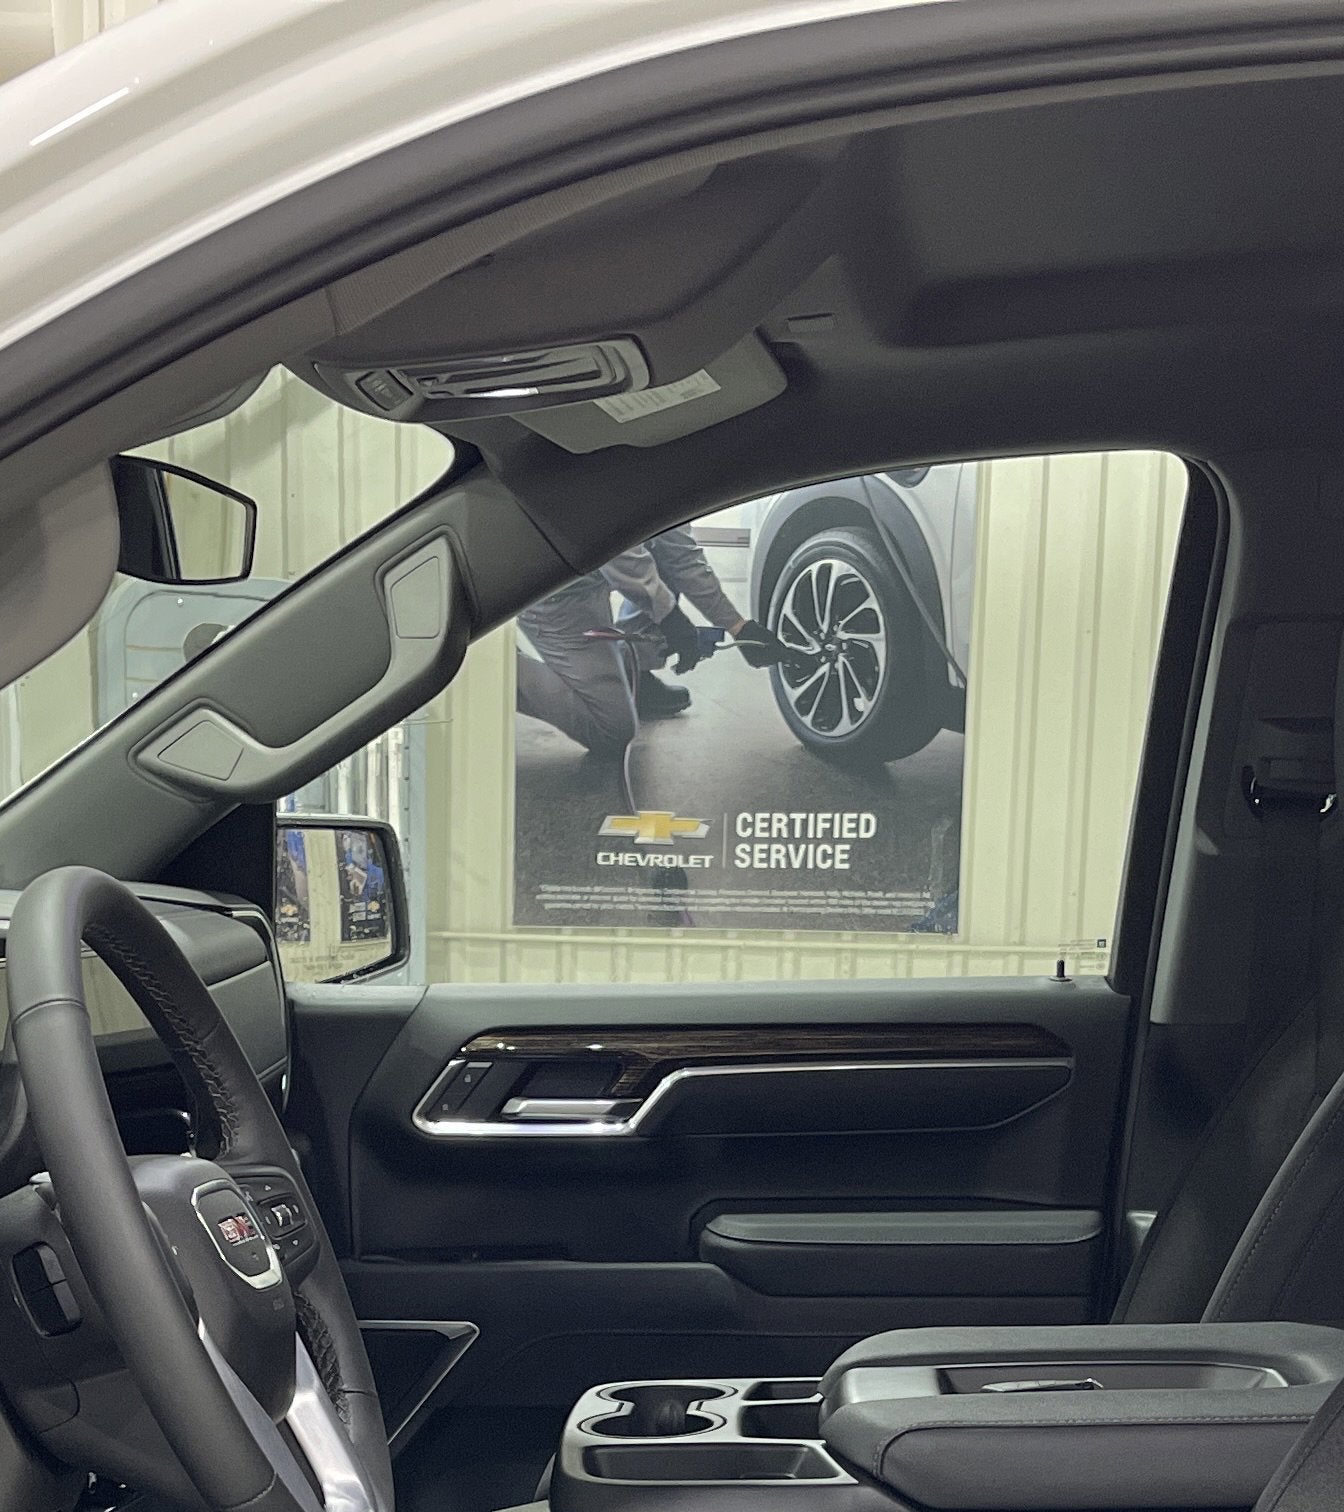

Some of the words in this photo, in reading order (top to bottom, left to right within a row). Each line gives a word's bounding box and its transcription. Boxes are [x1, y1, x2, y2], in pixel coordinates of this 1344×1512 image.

[735, 812, 878, 839] CERTIFIED
[596, 851, 714, 868] CHEVROLET
[734, 843, 851, 869] SERVICE
